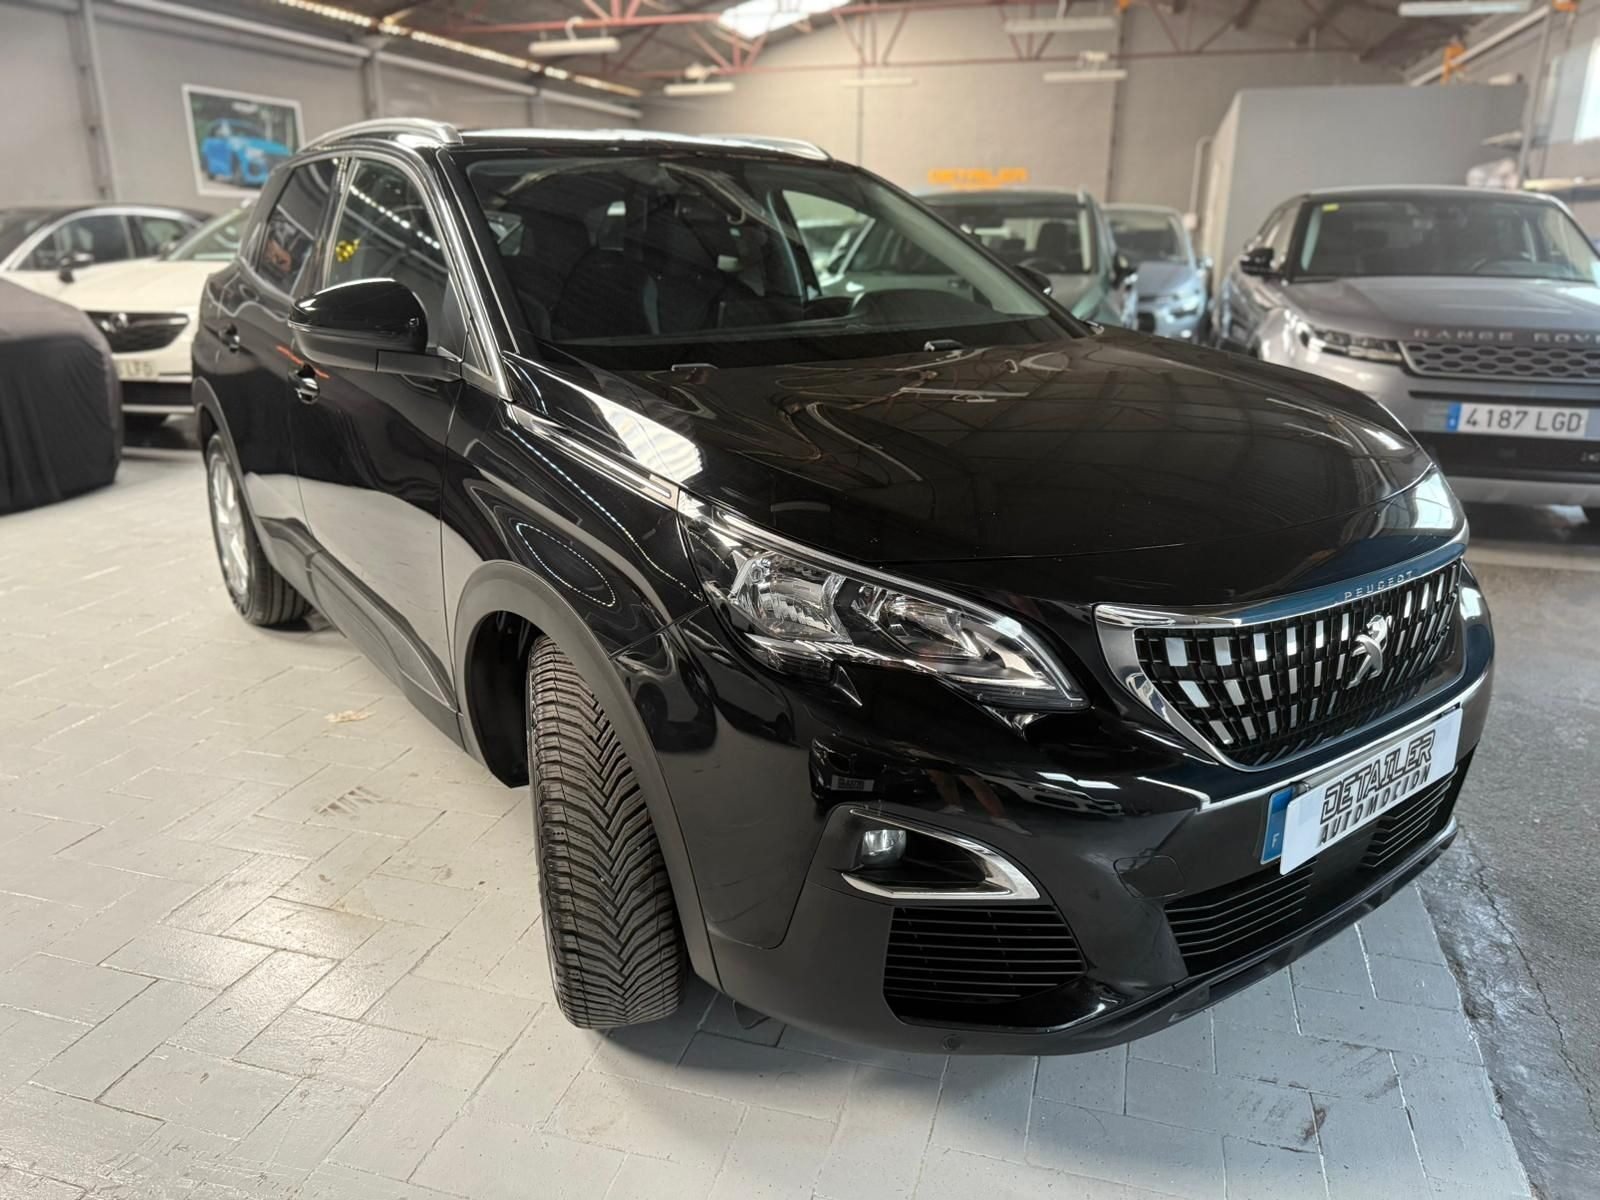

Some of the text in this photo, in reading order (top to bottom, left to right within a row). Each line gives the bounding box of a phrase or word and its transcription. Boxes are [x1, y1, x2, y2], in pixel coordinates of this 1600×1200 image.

[1414, 328, 1513, 341] RANGE
[1466, 408, 1581, 432] 4187 LGD
[1344, 570, 1413, 600] PEUGEOT
[1319, 729, 1436, 825] DETAILER
